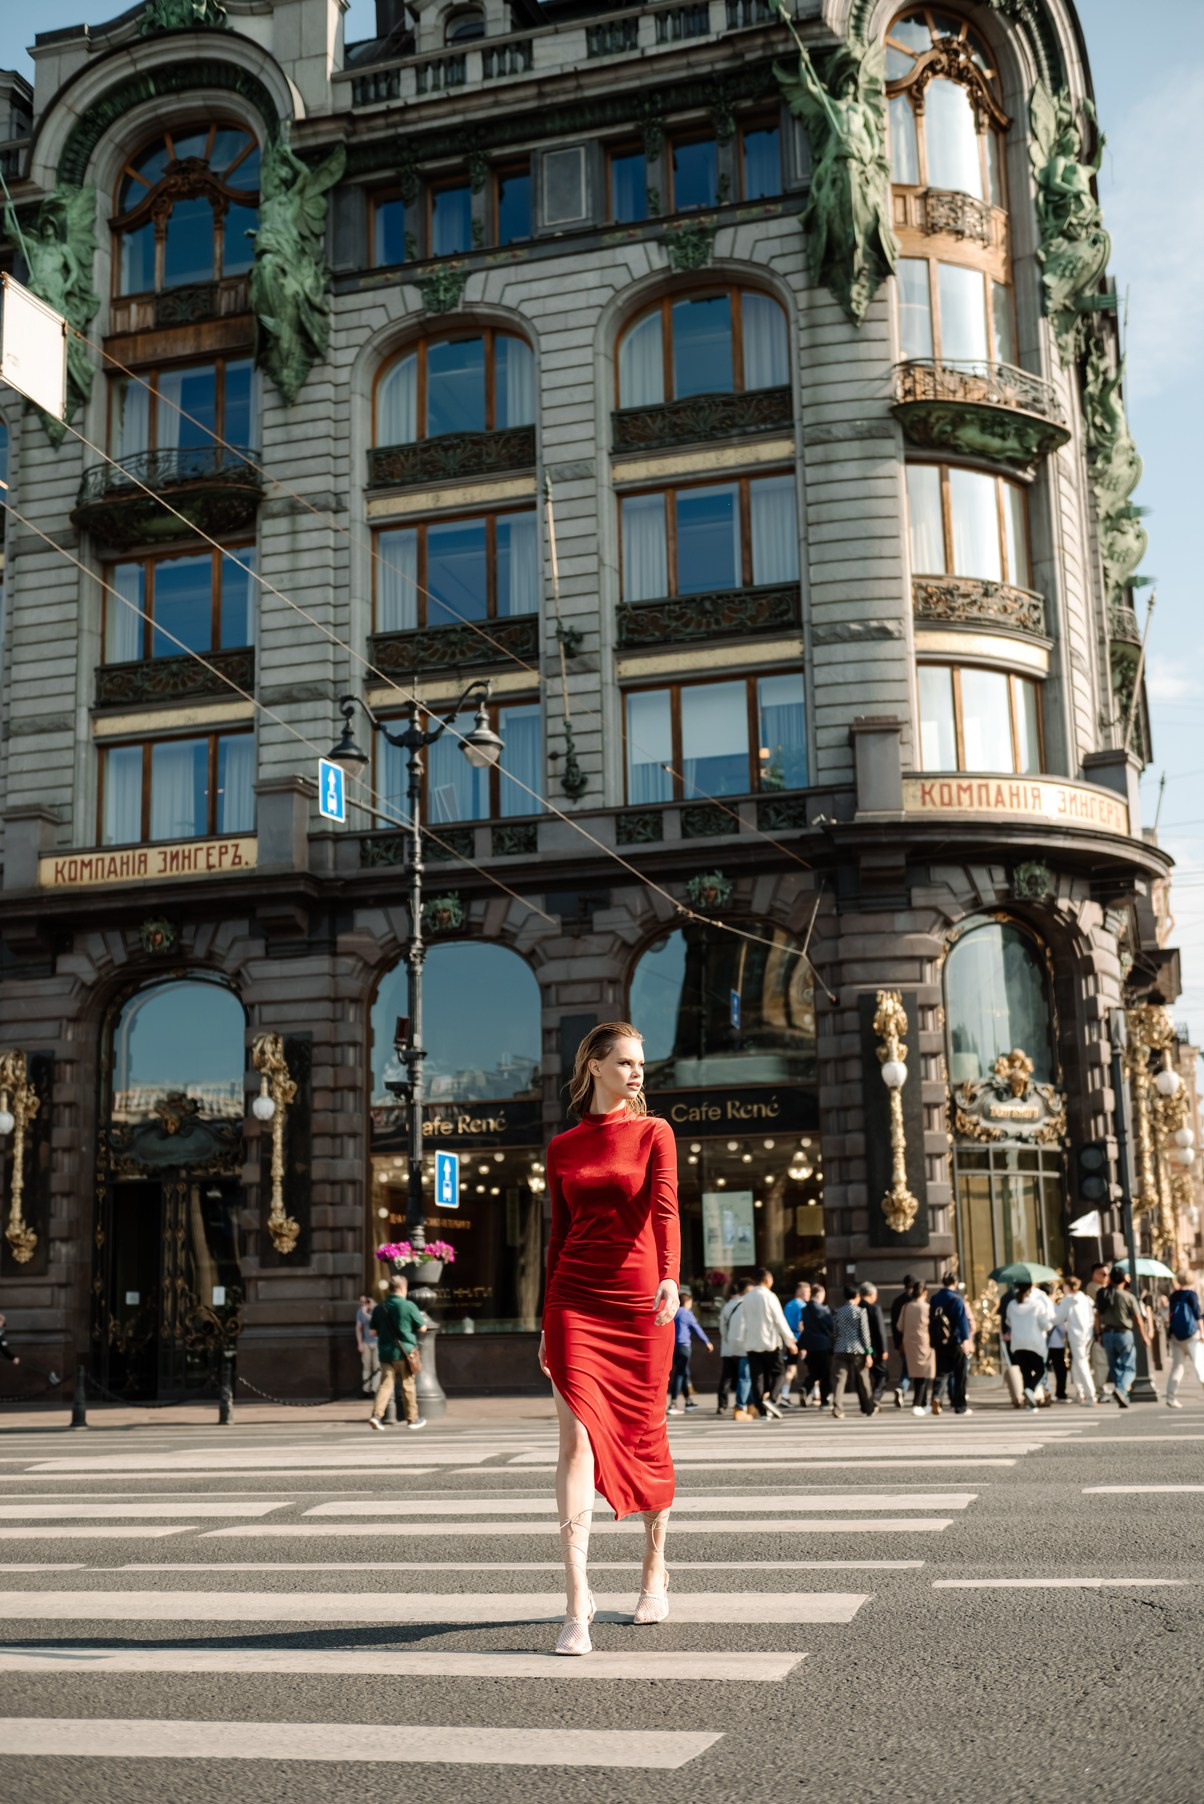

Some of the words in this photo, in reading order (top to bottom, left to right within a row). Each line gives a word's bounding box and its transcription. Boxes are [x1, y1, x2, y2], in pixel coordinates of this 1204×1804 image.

[920, 782, 1043, 811] КОМПАНІЯ
[54, 850, 148, 884] КОМПАНІЯ
[671, 1102, 722, 1122] Cafe
[726, 1095, 780, 1120] René
[405, 1115, 454, 1137] afe
[457, 1110, 507, 1135] René
